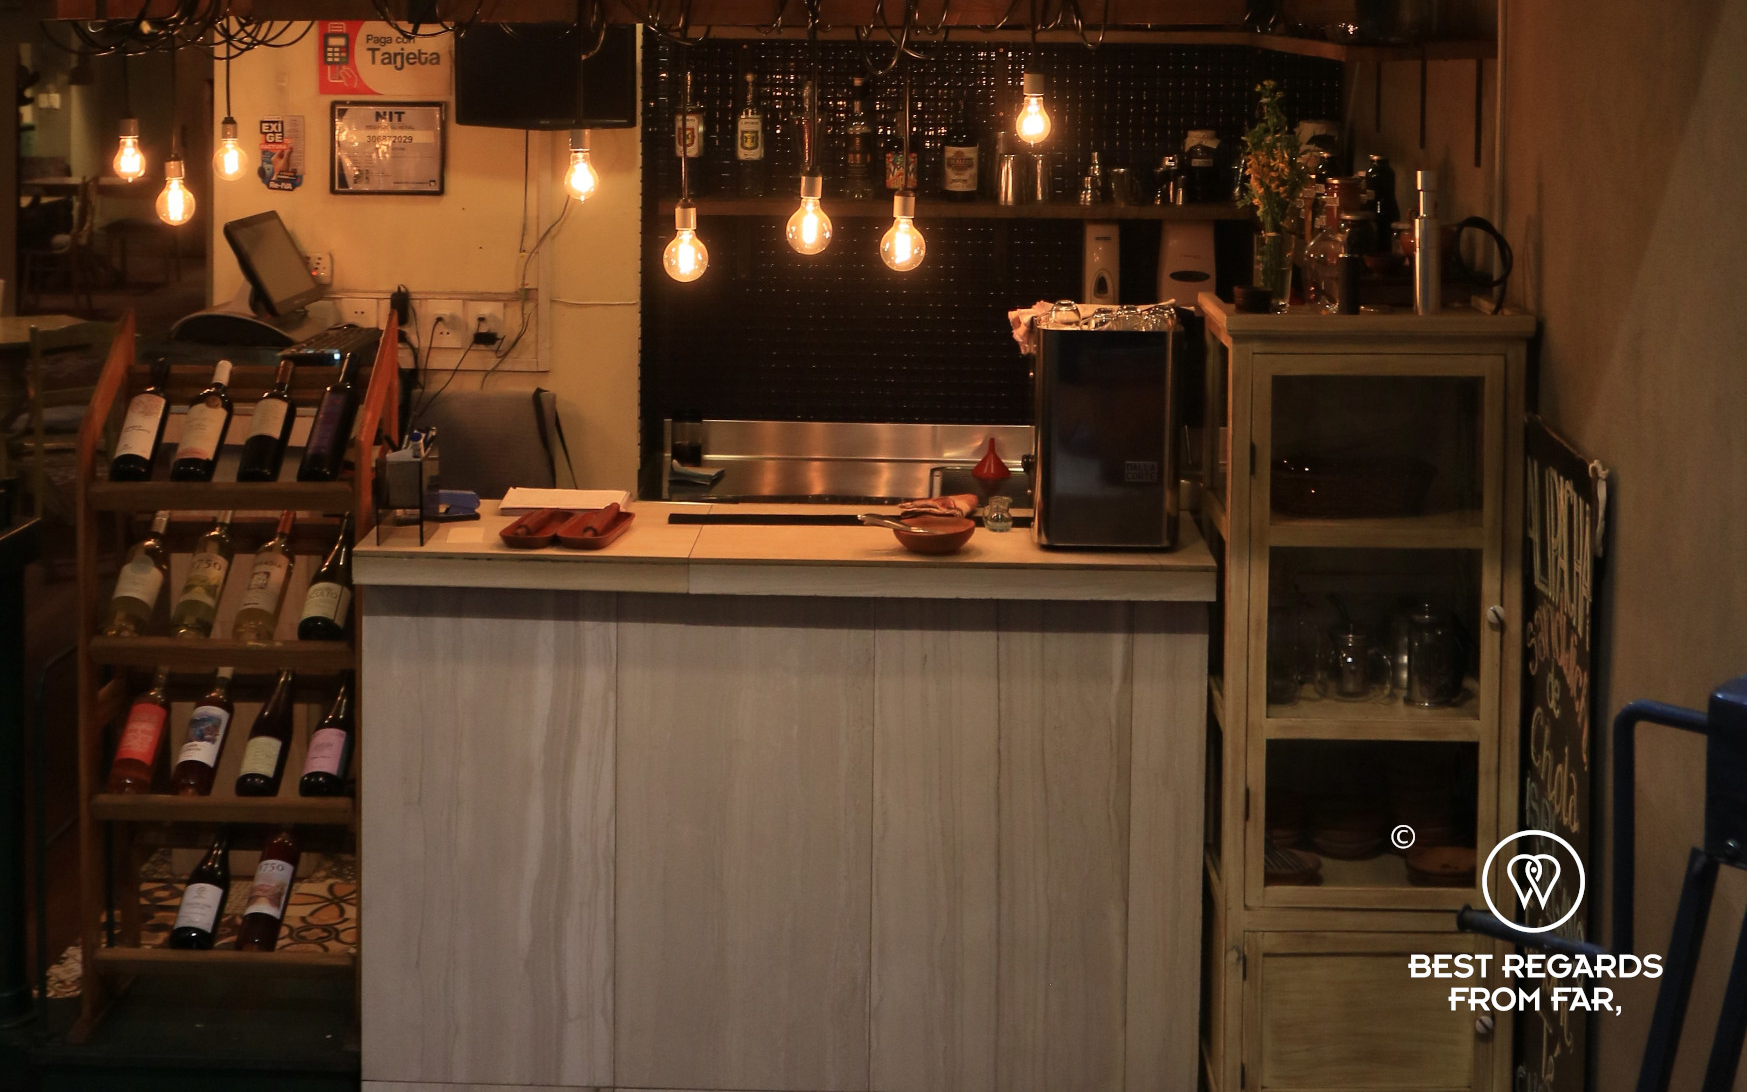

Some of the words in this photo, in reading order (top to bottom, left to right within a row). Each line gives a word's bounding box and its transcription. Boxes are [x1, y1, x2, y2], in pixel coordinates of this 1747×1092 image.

[366, 34, 393, 46] Paga
[395, 36, 416, 44] con
[367, 48, 440, 71] Tarjeta
[375, 111, 405, 122] NIT
